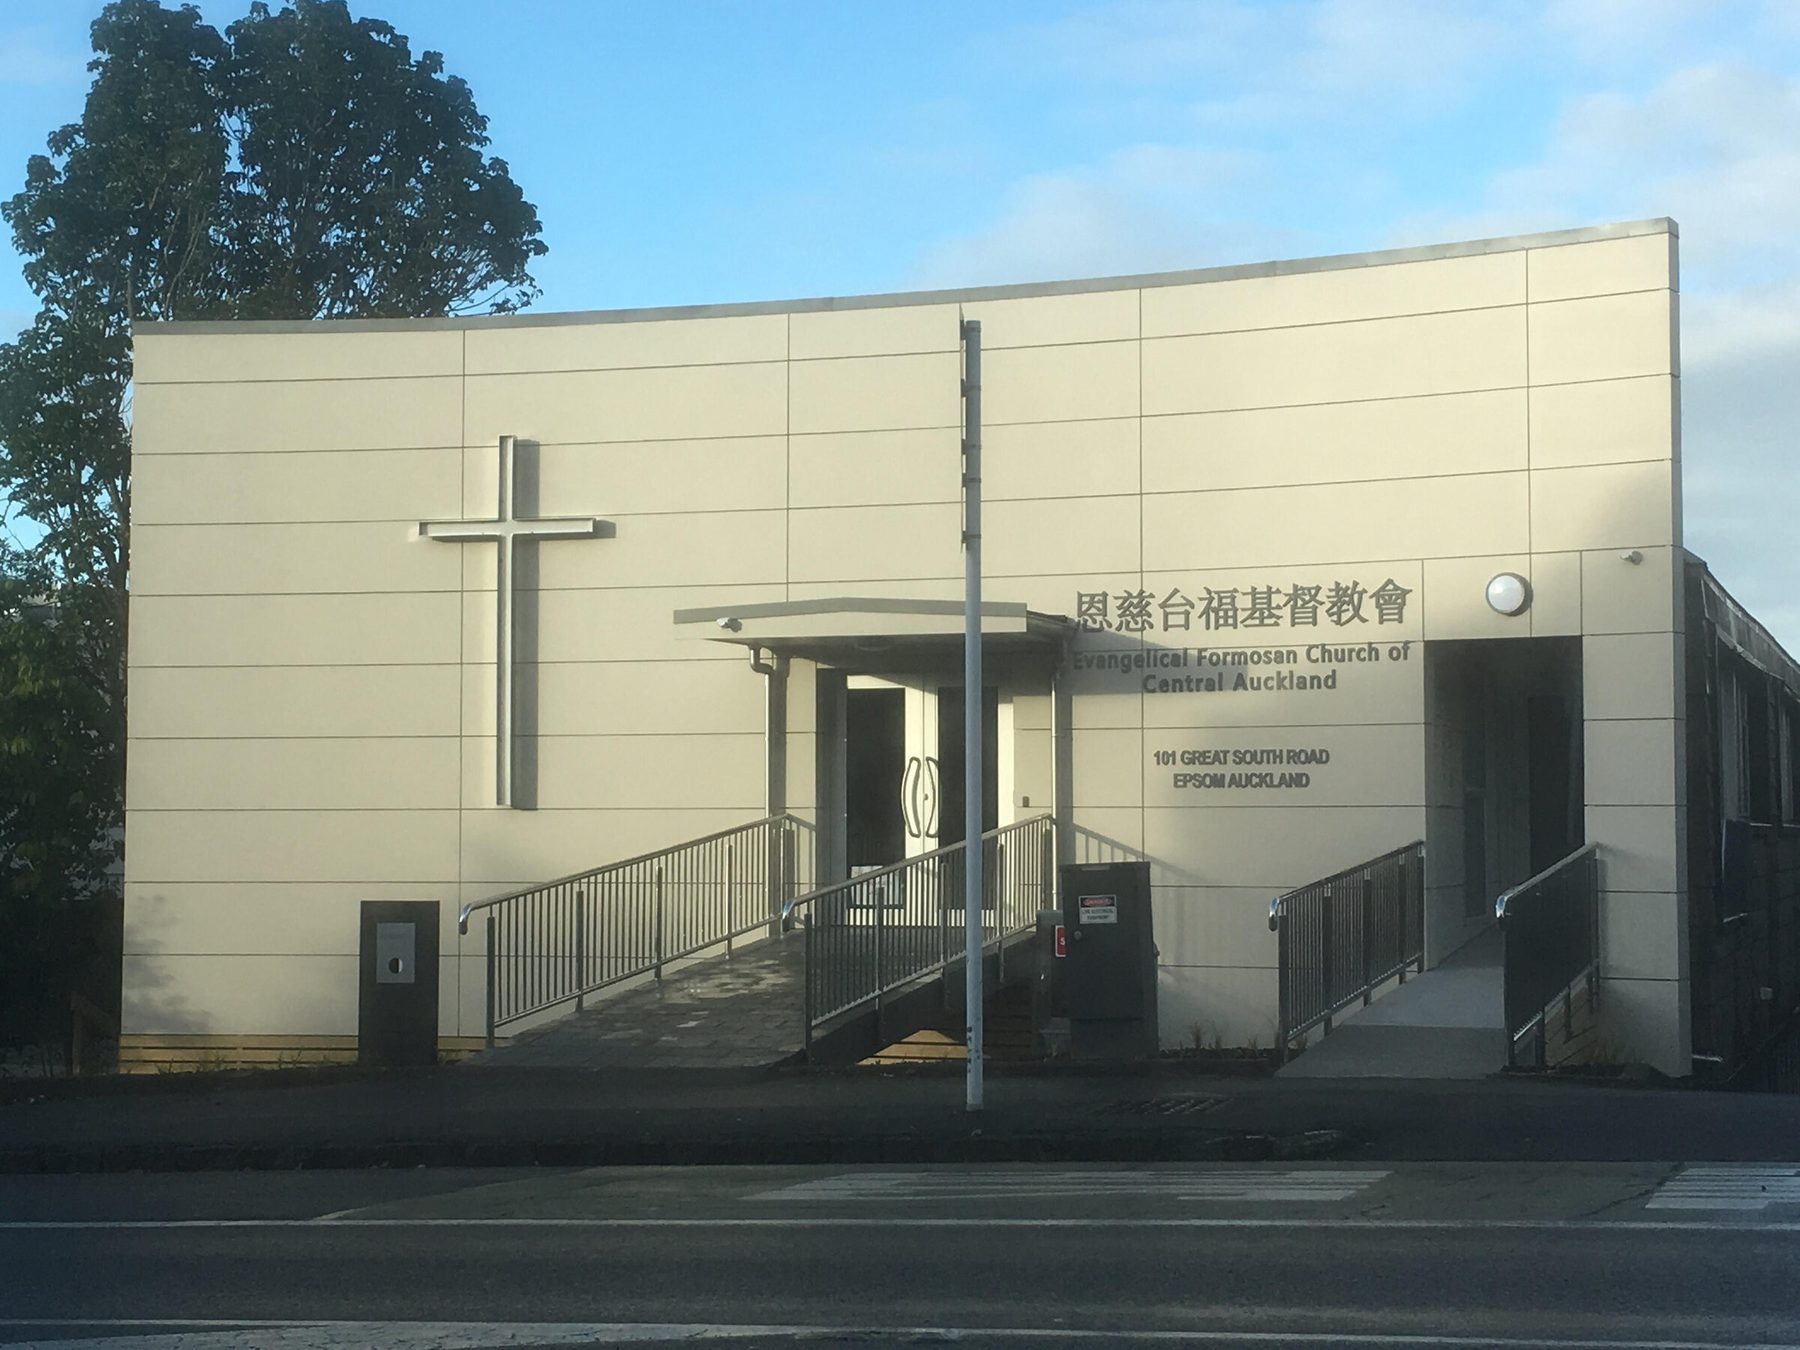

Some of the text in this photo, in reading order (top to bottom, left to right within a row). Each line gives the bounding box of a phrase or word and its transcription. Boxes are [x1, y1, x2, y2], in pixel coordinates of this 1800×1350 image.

[1076, 578, 1413, 634] 恩慈台福基督教會
[1074, 640, 1411, 674] Evangelical Formosan Church of
[1142, 669, 1337, 694] Central Auckland
[1153, 749, 1330, 766] 101 GREAT SOUTH ROAD
[1173, 772, 1311, 789] EPSOM AUCKLAND
